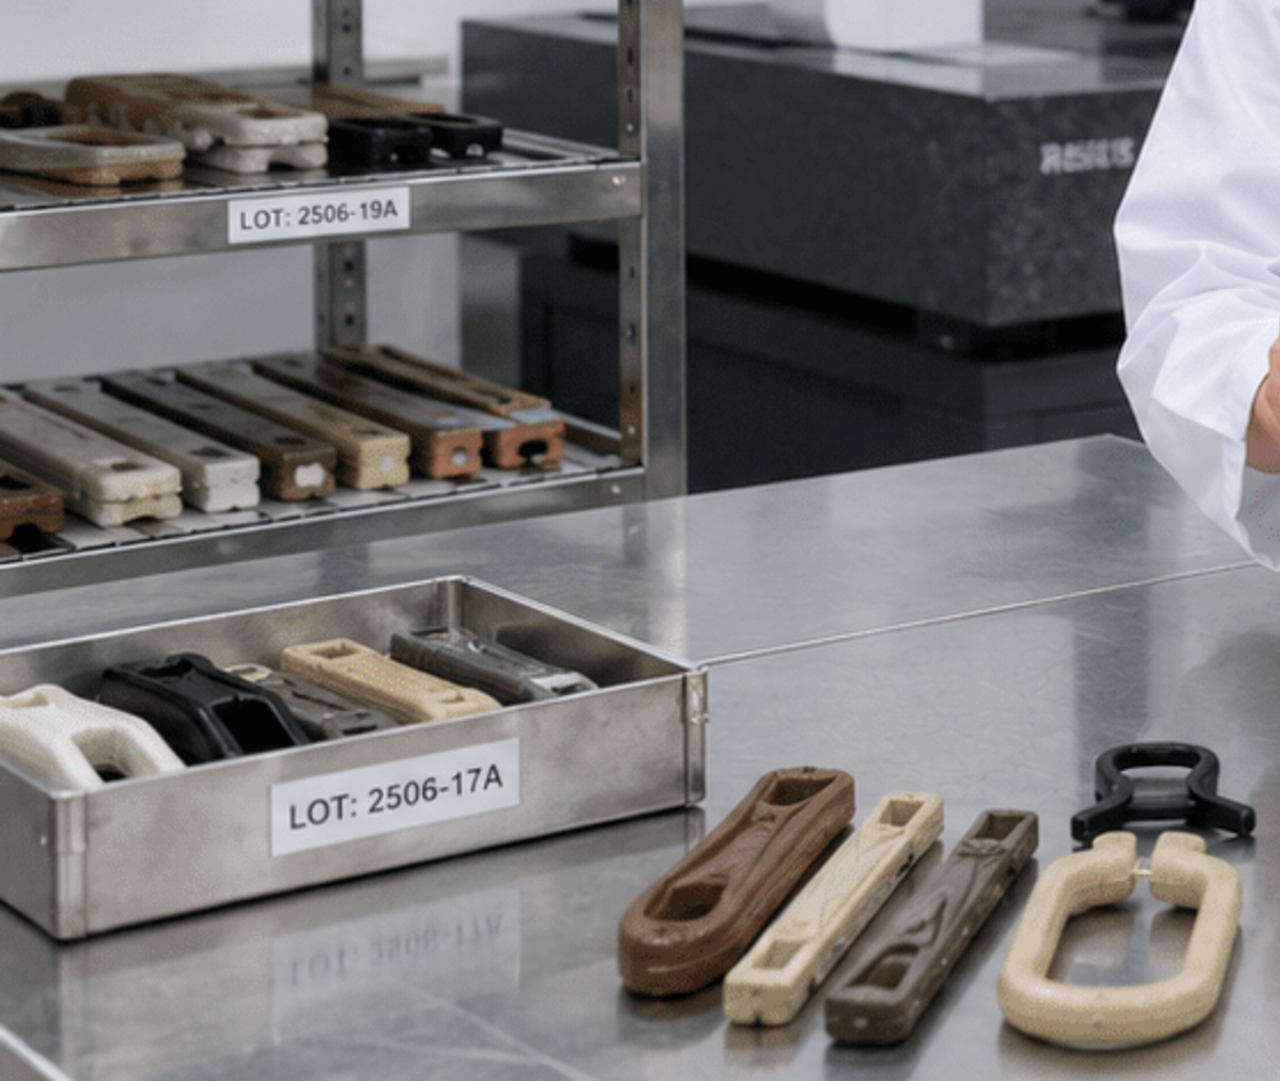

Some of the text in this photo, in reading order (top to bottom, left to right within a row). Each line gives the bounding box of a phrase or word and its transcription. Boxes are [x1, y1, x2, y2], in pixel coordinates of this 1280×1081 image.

[240, 199, 399, 231] LOT: 2506-19A
[289, 763, 504, 831] LOT: 2506-17A
